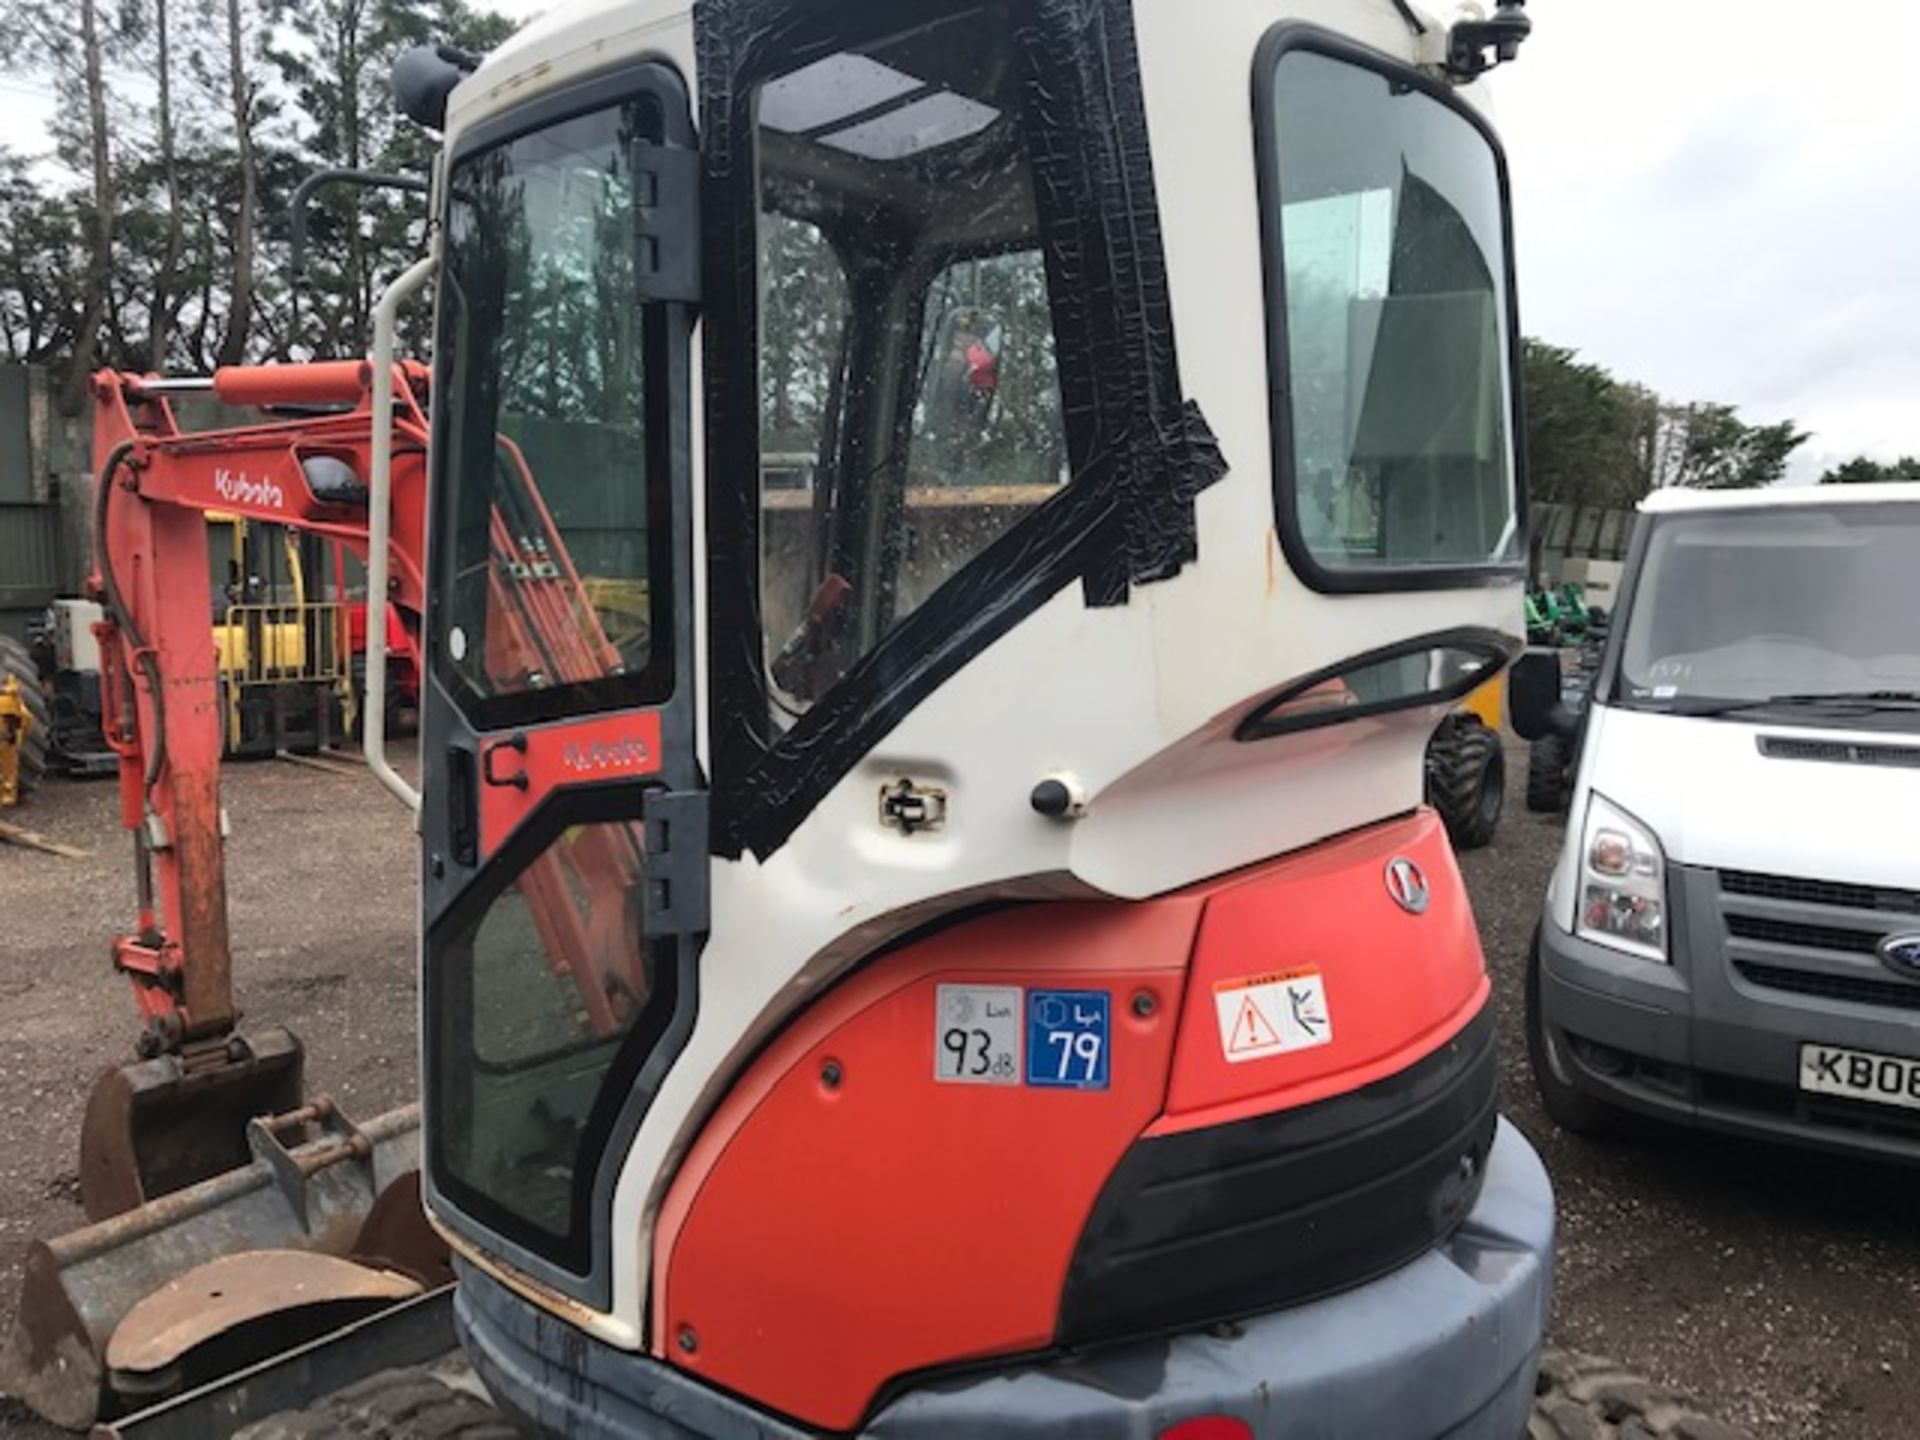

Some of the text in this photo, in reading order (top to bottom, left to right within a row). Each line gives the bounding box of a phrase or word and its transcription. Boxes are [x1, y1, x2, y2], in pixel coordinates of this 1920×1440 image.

[215, 468, 283, 508] Kubota
[944, 1028, 991, 1075] 93
[1049, 1031, 1100, 1080] 79
